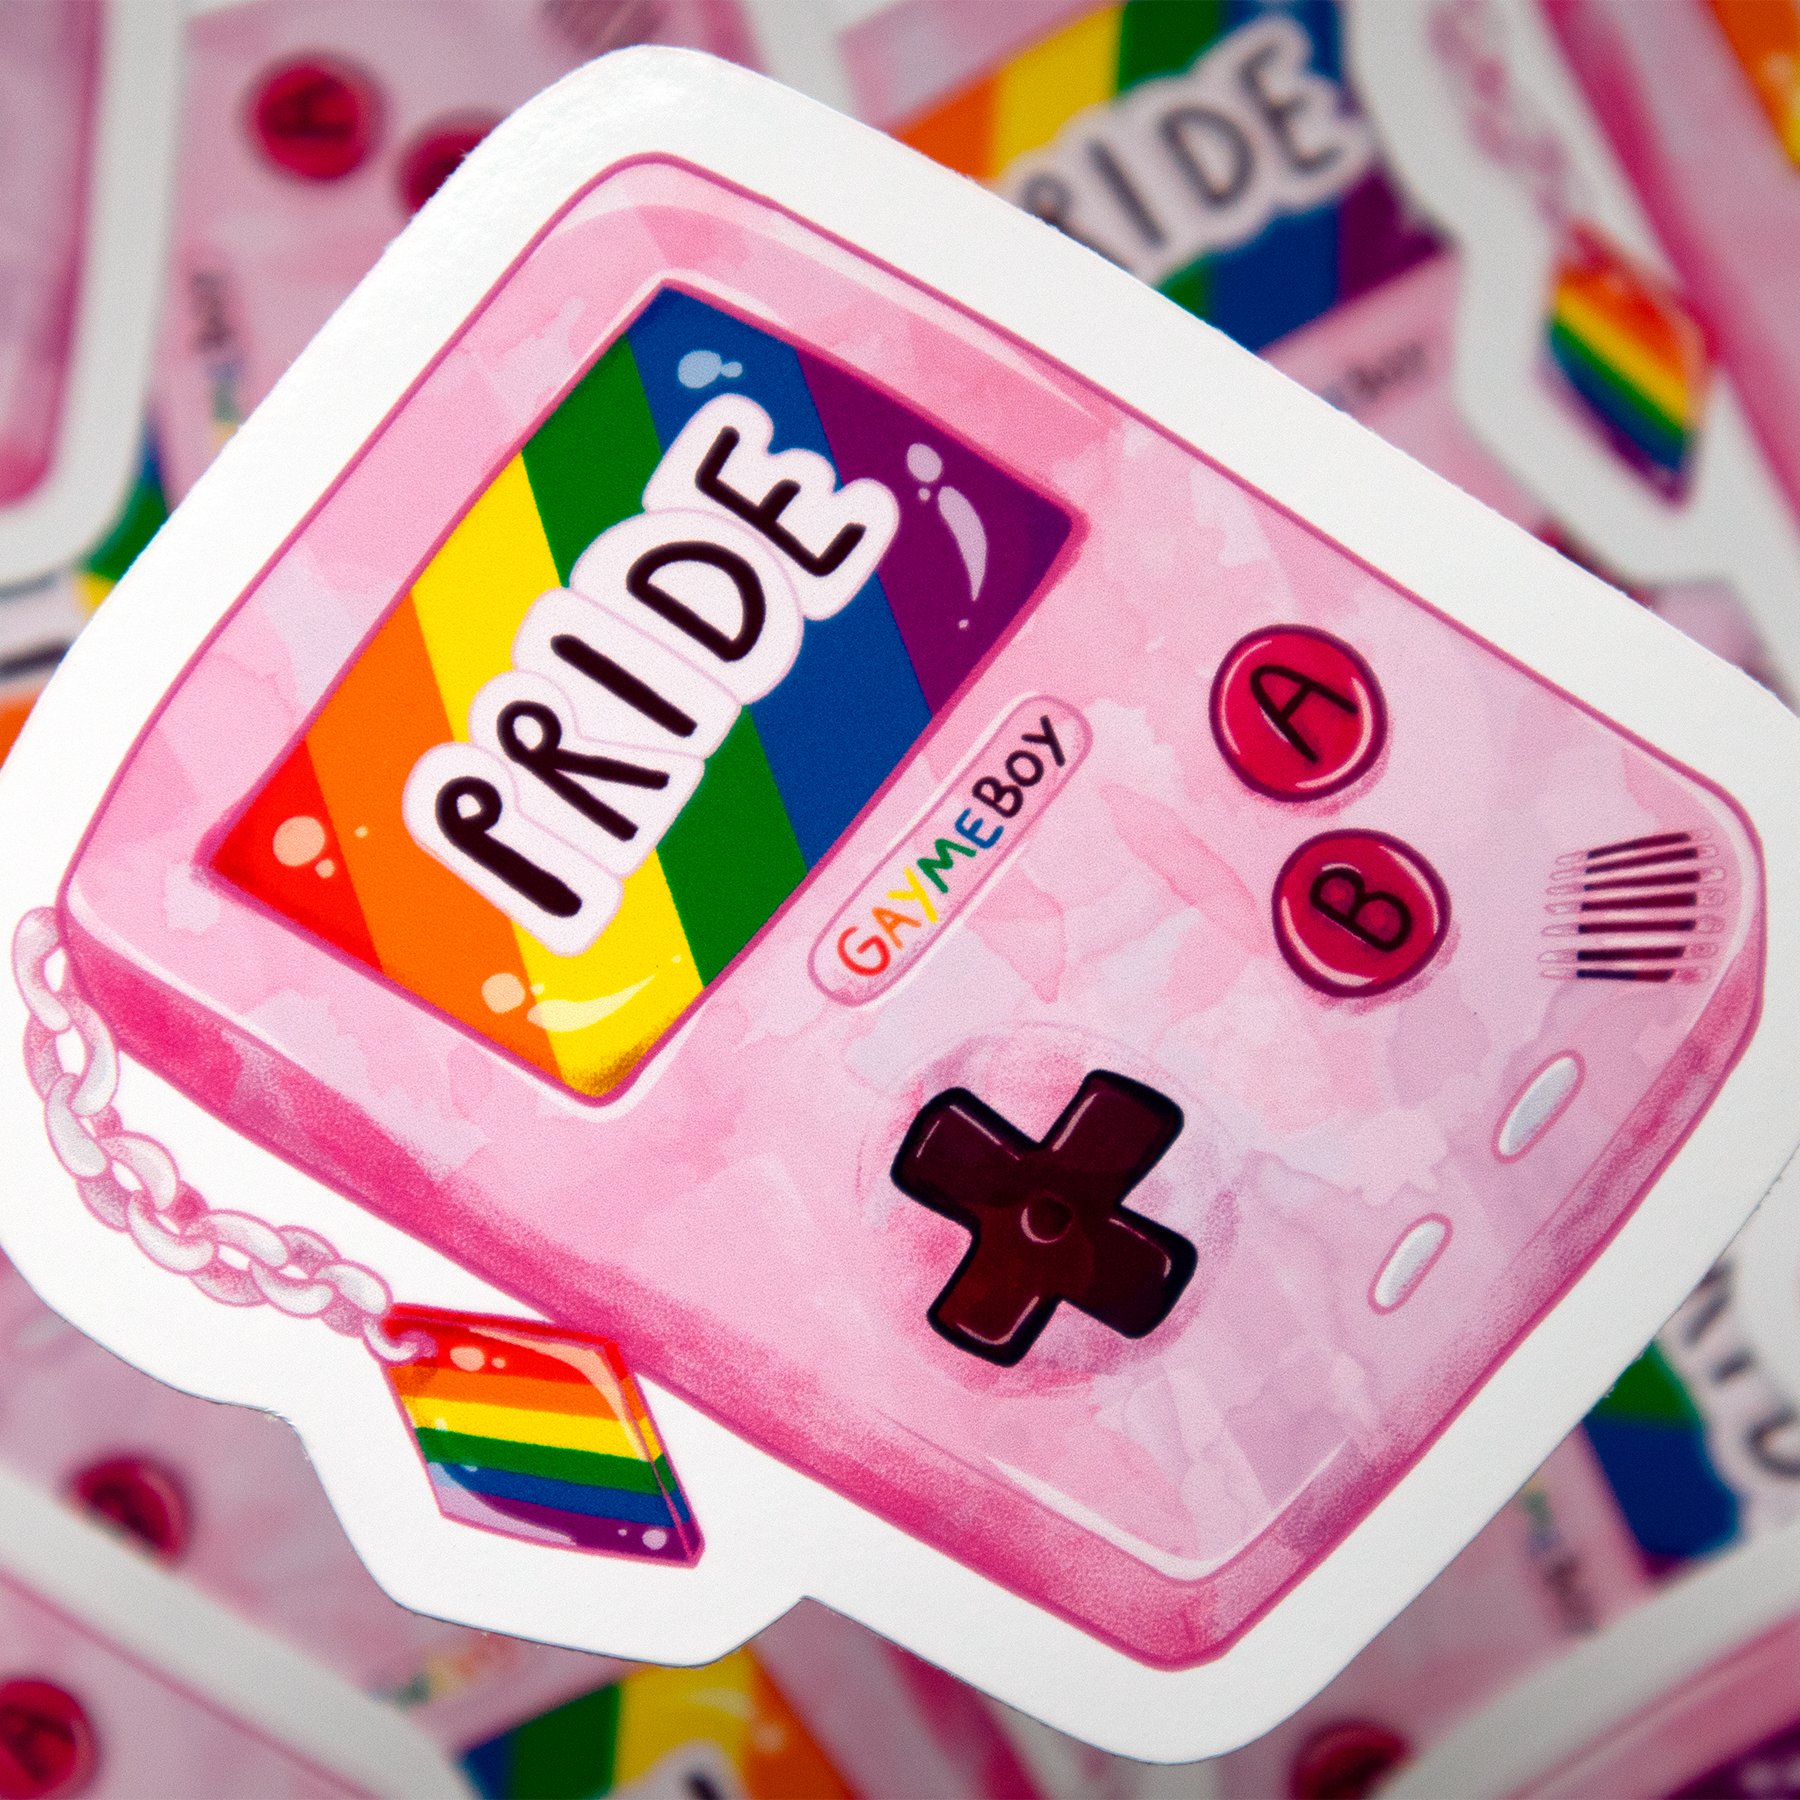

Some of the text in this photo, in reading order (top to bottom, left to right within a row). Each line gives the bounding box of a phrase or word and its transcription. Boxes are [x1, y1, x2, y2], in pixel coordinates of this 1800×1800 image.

[434, 425, 867, 918] PRIDE
[1249, 663, 1359, 765] A
[836, 715, 1067, 977] GAYMEBOY
[1308, 866, 1412, 953] B
